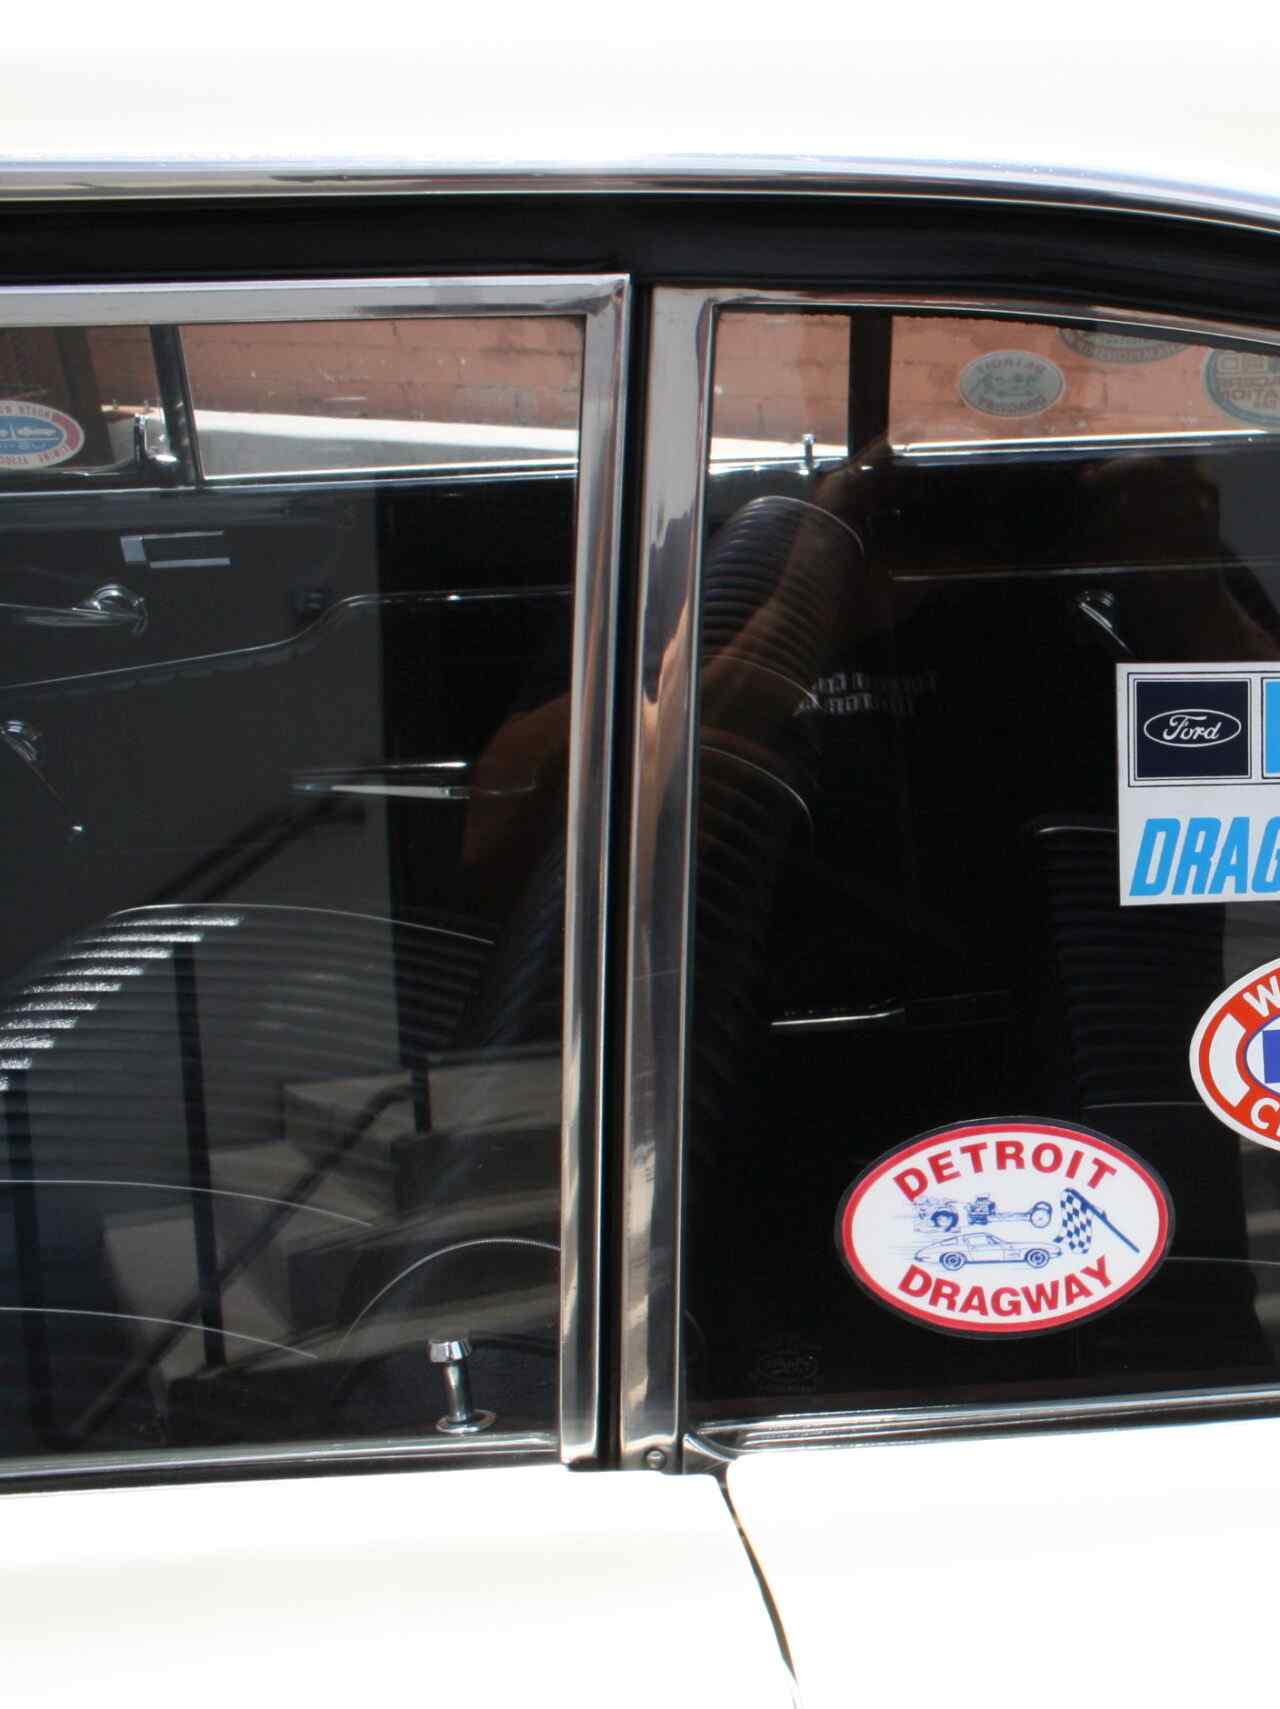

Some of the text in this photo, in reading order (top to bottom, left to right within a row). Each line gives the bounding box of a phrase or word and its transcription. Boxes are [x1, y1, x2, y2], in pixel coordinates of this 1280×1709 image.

[1163, 712, 1221, 741] Ford
[892, 1140, 1118, 1202] DETROIT
[898, 1254, 1114, 1317] DRAGWAY
